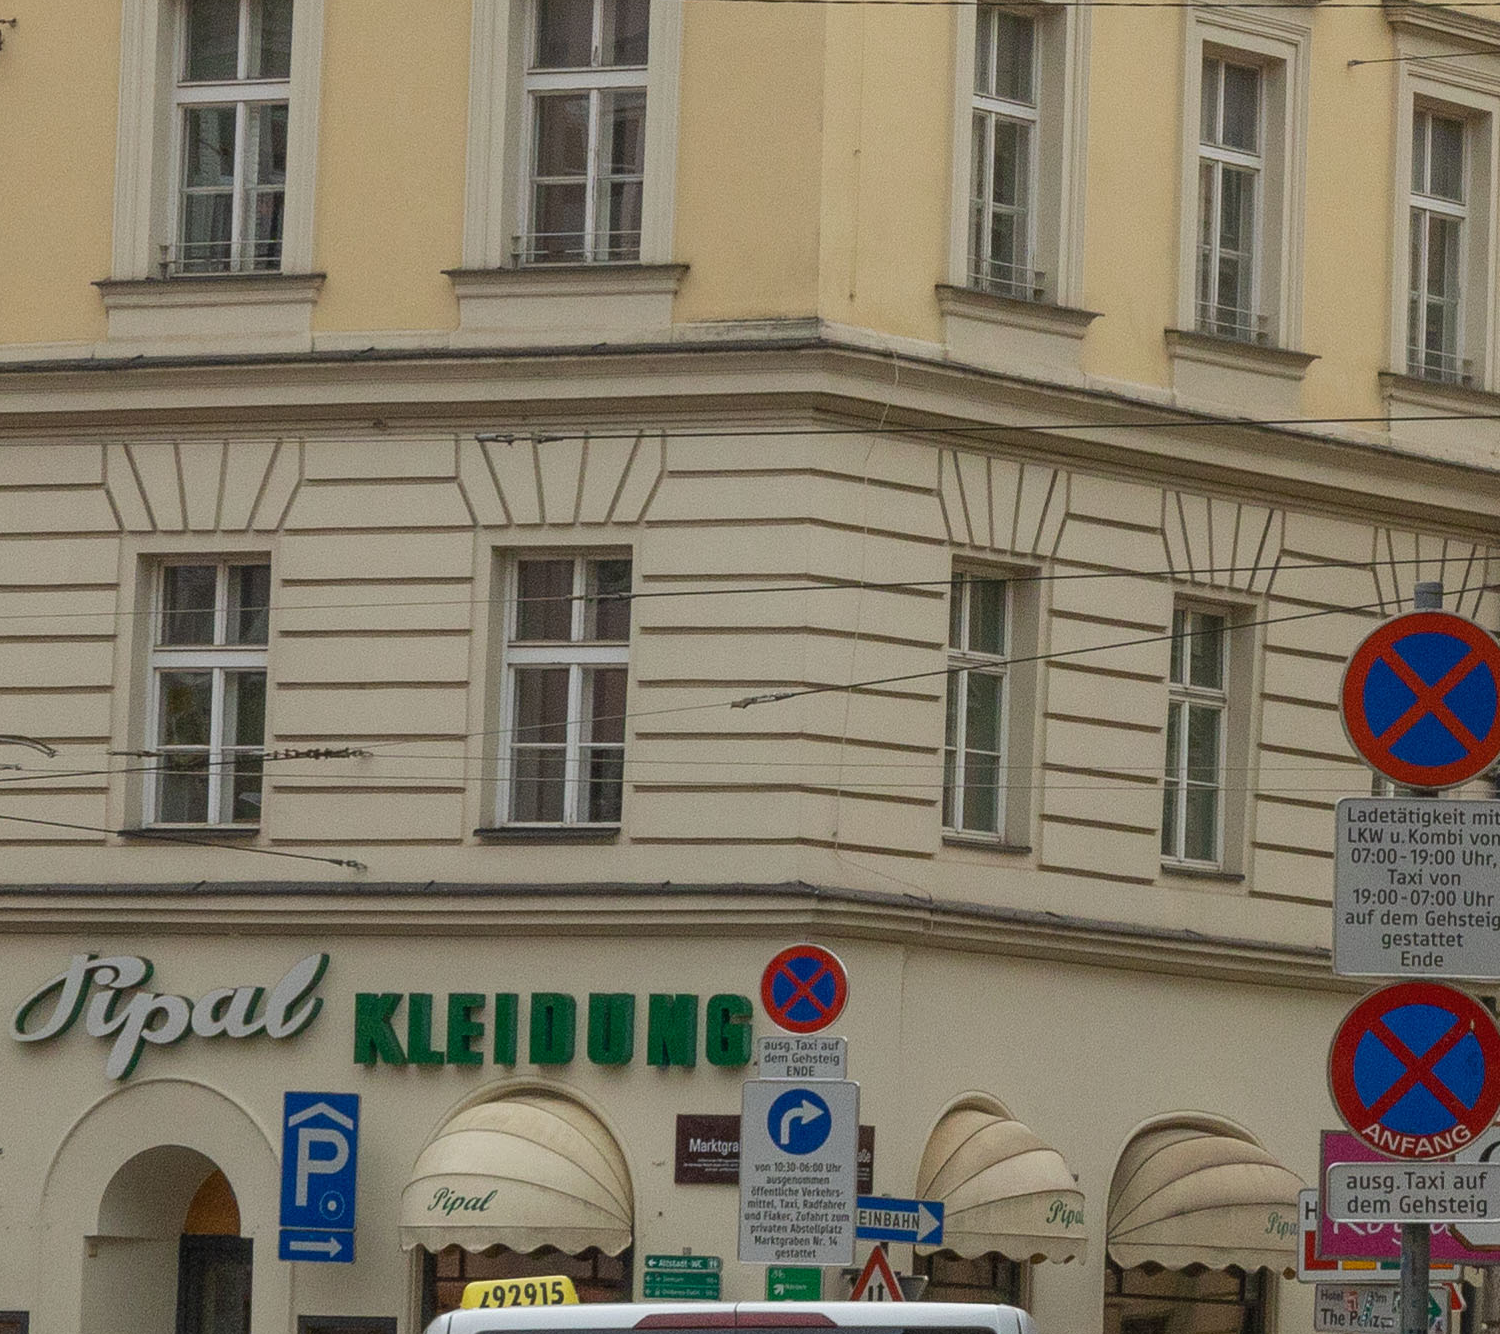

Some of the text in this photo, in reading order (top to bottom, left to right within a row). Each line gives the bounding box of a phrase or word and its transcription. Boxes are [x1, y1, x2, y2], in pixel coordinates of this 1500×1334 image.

[1347, 806, 1500, 830] Ladetätigkeit mit
[1348, 828, 1500, 847] LKW von
[1463, 850, 1498, 869] Uhr,
[1387, 869, 1461, 886] Taxi von
[1463, 891, 1495, 907] Uhr
[1345, 909, 1500, 931] auf dem Gehsteig
[1382, 931, 1463, 949] gestattet
[1401, 950, 1444, 967] Ende
[354, 992, 754, 1069] KLEIDUNG
[821, 1040, 840, 1050] auf
[764, 1053, 840, 1067] dem Gehsteig
[786, 1066, 816, 1077] ENDE
[689, 1138, 740, 1156] Marktgra
[1362, 1122, 1473, 1155] ANFANG
[292, 1128, 350, 1207] P
[754, 1162, 771, 1172] von
[826, 1163, 842, 1173] Uhr
[766, 1176, 830, 1187] ausgenommen
[1405, 1170, 1445, 1189] Taxi
[1453, 1171, 1487, 1190] auf
[426, 1184, 498, 1218] Pipal
[751, 1187, 844, 1198] öffentliche Verkehrs-
[803, 1199, 847, 1209] Radfahrer
[1347, 1195, 1488, 1218] dem Gehsteig
[744, 1211, 761, 1221] und
[796, 1211, 829, 1222] Zufahrt
[831, 1213, 850, 1222] zum
[859, 1210, 920, 1230] EINBAHN
[1265, 1212, 1298, 1236] Pipa
[750, 1224, 842, 1235] privaten Abstellplatz
[754, 1235, 810, 1247] Marktgraben
[813, 1236, 826, 1246] Nr.
[775, 1249, 816, 1259] gestattet
[1320, 1289, 1343, 1302] Hotel
[1321, 1308, 1346, 1326] The
